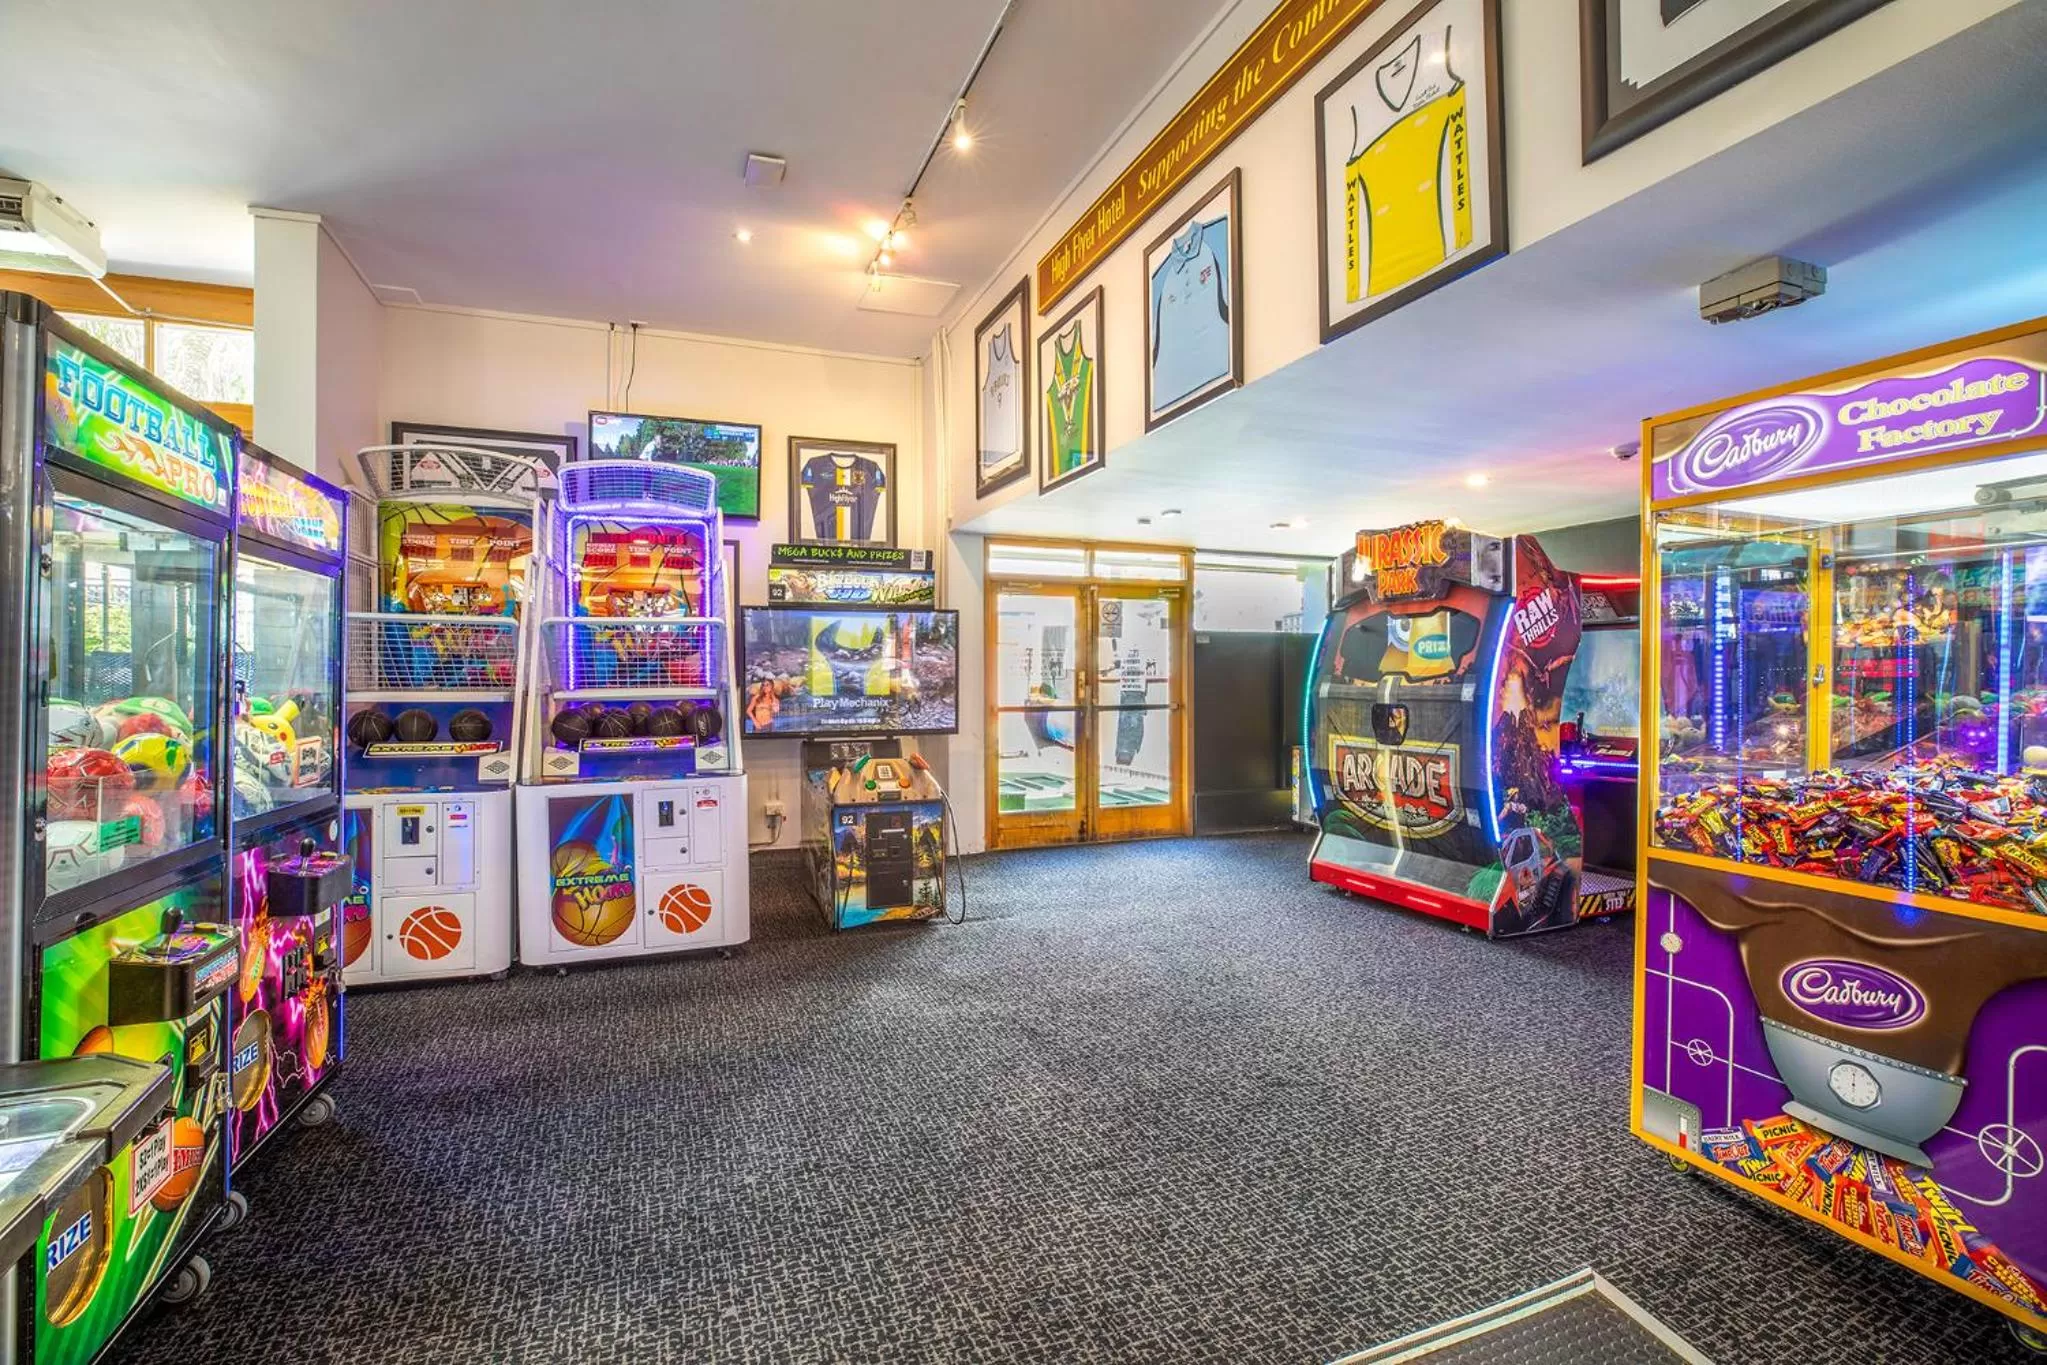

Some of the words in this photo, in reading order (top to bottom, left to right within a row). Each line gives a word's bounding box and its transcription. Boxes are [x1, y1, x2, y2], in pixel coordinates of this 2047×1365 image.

[1051, 244, 1071, 285] High
[1072, 231, 1095, 264] Flyer
[1097, 183, 1126, 238] Hotel
[1137, 94, 1229, 200] Supporting
[1233, 57, 1266, 106] the
[1450, 106, 1466, 211] WATTLES
[1345, 179, 1357, 270] WATTLES
[56, 351, 217, 470] FOOTBALL
[1838, 370, 2029, 426] Chocolate
[1692, 421, 1803, 479] Cadbury
[1857, 408, 2004, 452] Factory
[165, 453, 217, 502] PRO
[450, 538, 475, 546] TIME
[489, 539, 521, 547] POINT
[777, 546, 808, 557] MEGA
[846, 548, 868, 559] AND
[870, 549, 905, 561] PRIZES
[1377, 566, 1419, 598] PARK
[1513, 587, 1554, 634] RAW
[1520, 608, 1560, 647] THRILLS
[812, 697, 838, 710] Play
[839, 696, 889, 708] Mechanix
[1343, 752, 1449, 807] ARCADE
[841, 815, 854, 825] 92
[556, 871, 630, 888] EXTREME
[1790, 967, 1903, 1010] Cadbury
[233, 1041, 259, 1072] RIZE
[1762, 1123, 1798, 1139] PICNIC
[1821, 1182, 1835, 1216] PICNIC
[46, 1211, 93, 1273] RIZE
[1935, 1214, 1957, 1265] PICNIC
